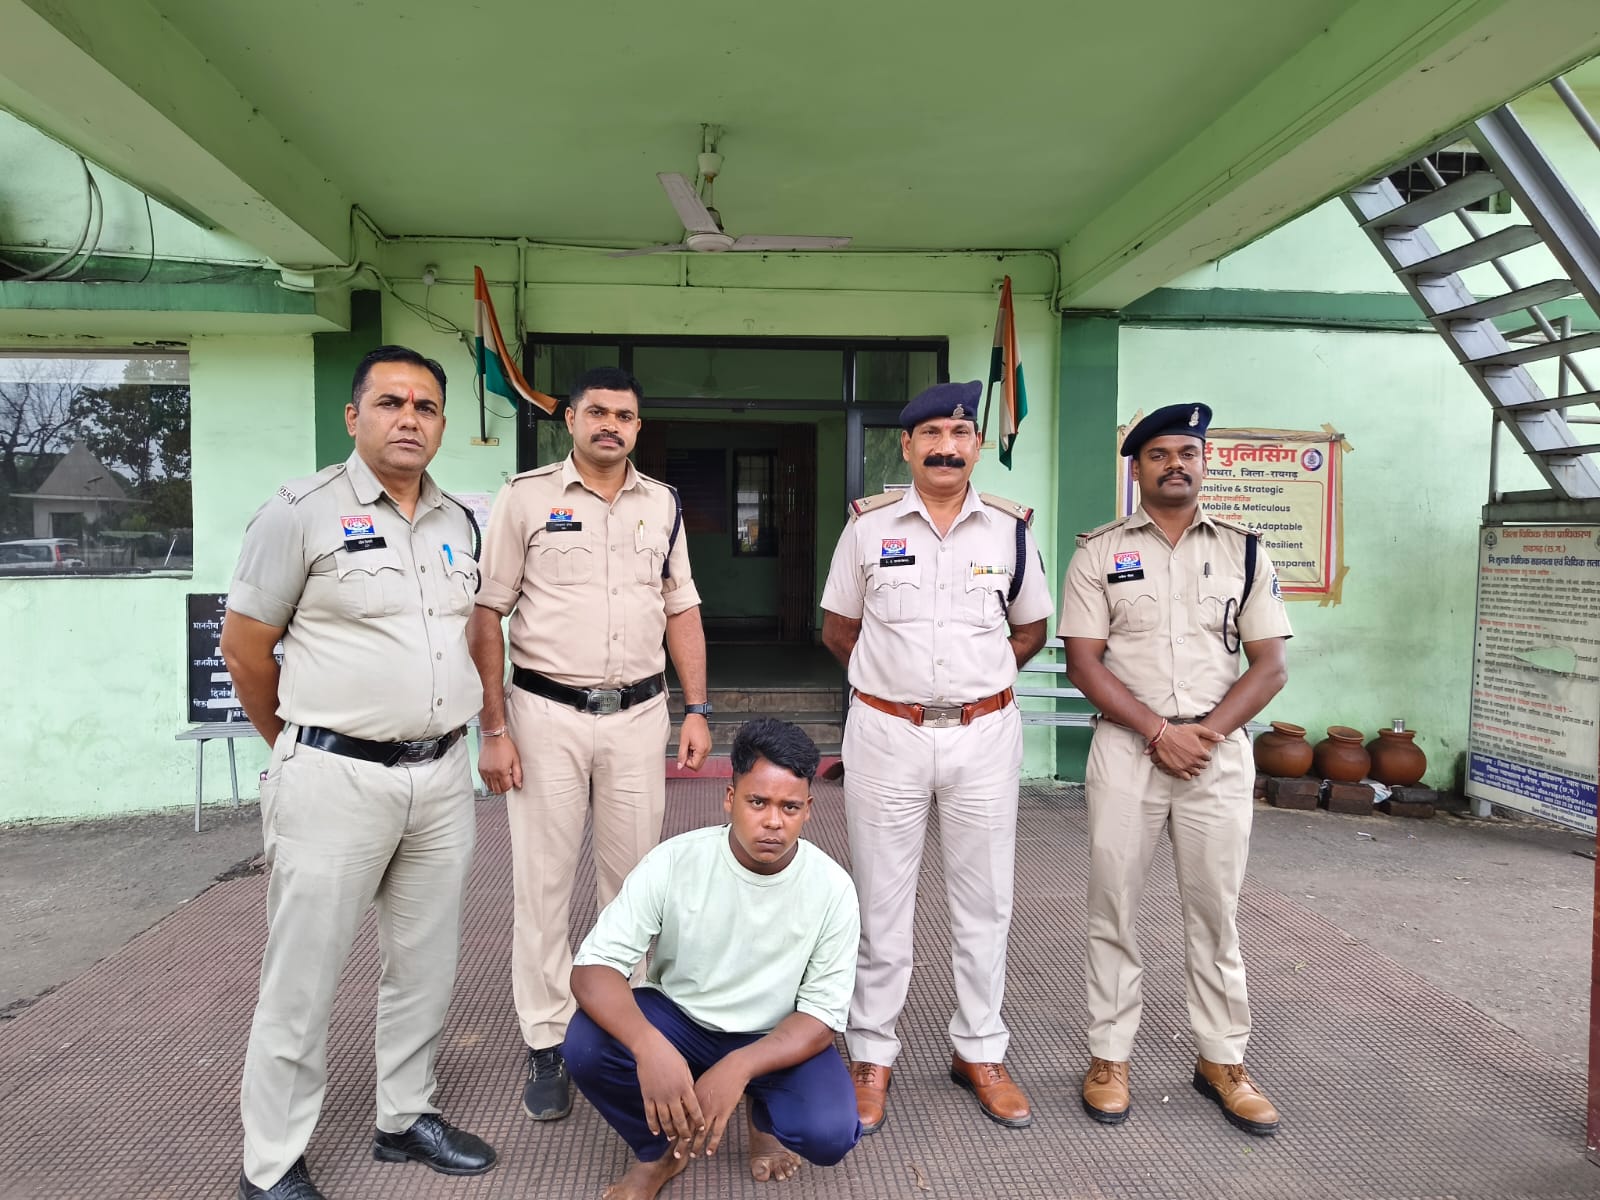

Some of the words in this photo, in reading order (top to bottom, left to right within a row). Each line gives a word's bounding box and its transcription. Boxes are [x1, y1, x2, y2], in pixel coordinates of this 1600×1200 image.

[1217, 443, 1297, 467] पुलिसिंग
[1199, 484, 1233, 492] ensitive
[1243, 485, 1284, 495] Strategic
[1202, 502, 1232, 510] Mobile
[1242, 504, 1291, 512] Meticulous
[1256, 522, 1303, 532] Adaptable
[1265, 541, 1303, 549] Resilient
[1586, 559, 1600, 567] सला
